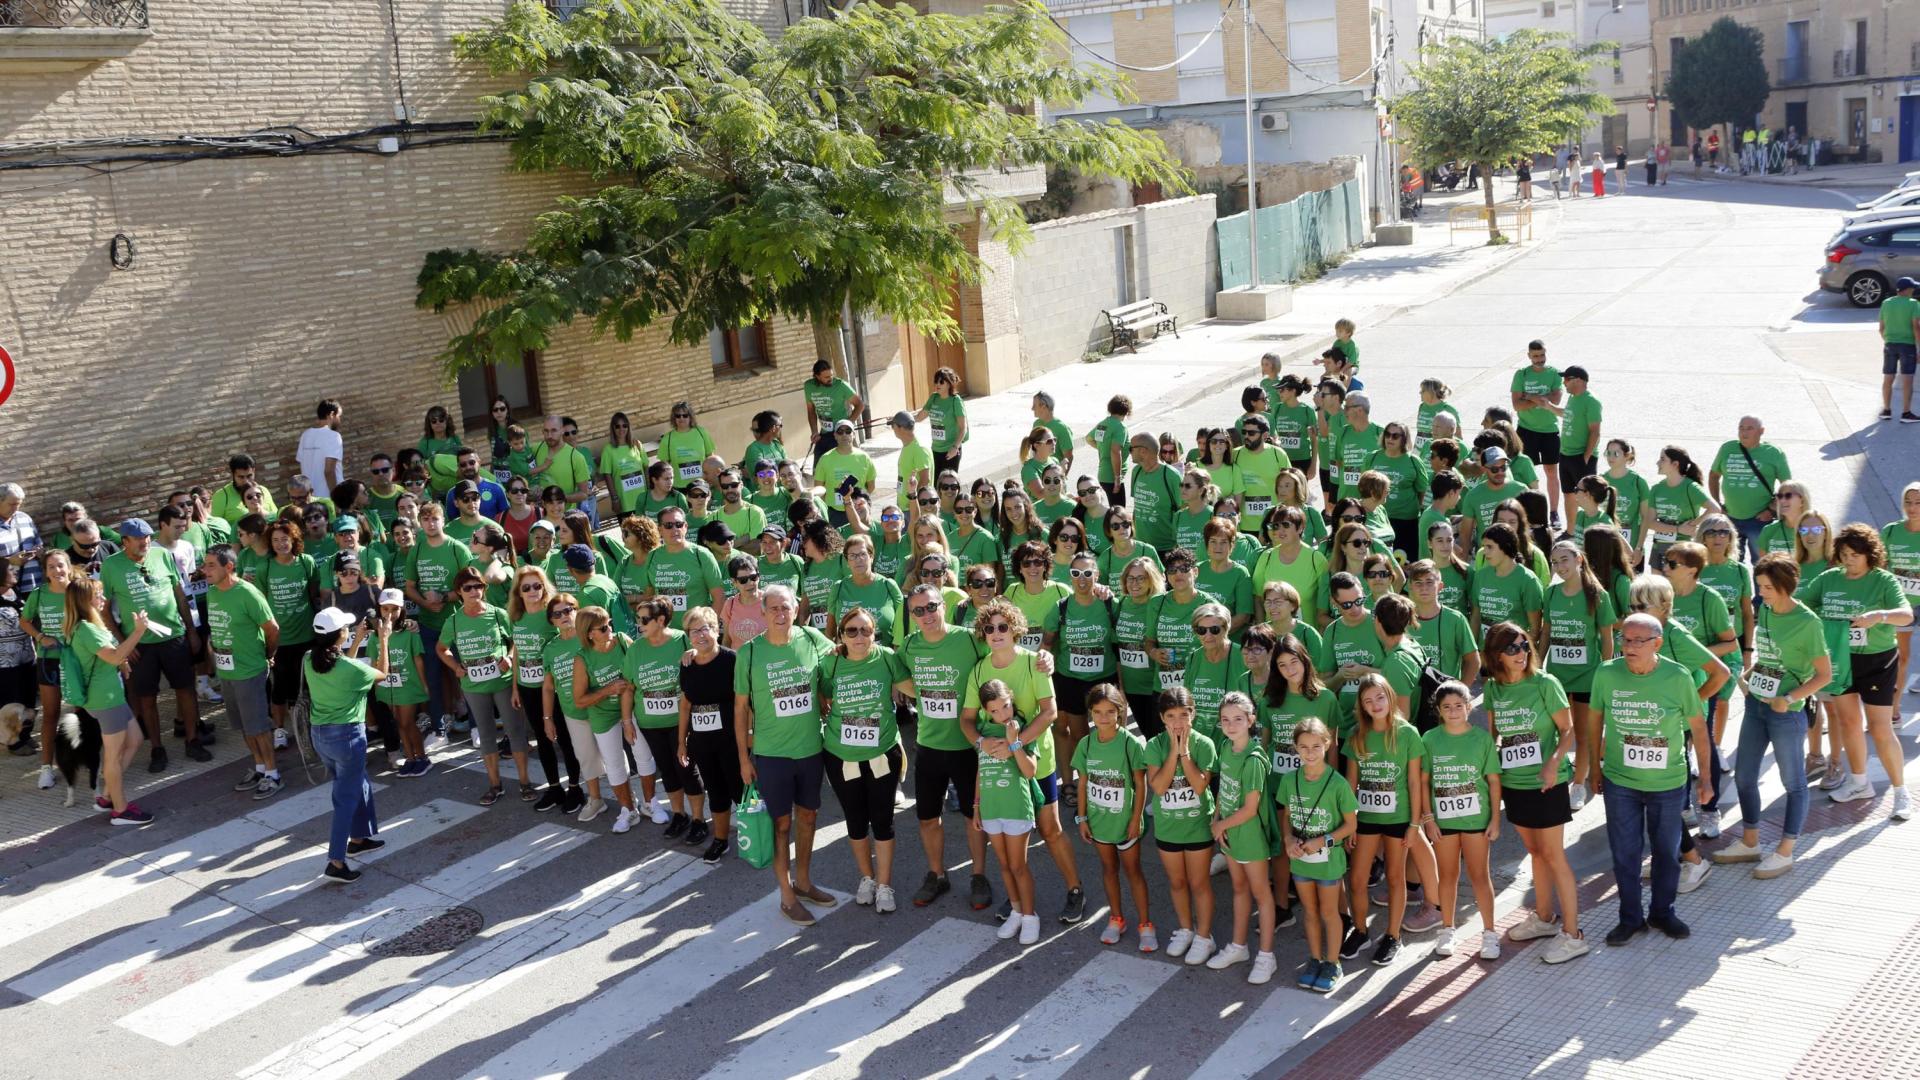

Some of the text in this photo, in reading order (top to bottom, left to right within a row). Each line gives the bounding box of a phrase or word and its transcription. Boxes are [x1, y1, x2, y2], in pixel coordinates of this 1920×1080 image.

[496, 471, 510, 479] 1903
[683, 467, 700, 476] 1865
[1345, 473, 1359, 481] 013
[625, 478, 642, 487] 1868
[1248, 503, 1268, 511] 1881
[1075, 624, 1102, 632] marcha
[465, 635, 491, 644] marcha
[1121, 652, 1143, 663] 0271
[1343, 649, 1368, 658] marcha
[1555, 648, 1582, 658] 1869
[1073, 657, 1099, 667] 0281
[470, 664, 496, 678] 0129
[521, 669, 544, 679] 0120
[648, 665, 674, 675] marcha
[779, 666, 807, 677] marcha
[923, 665, 952, 673] marcha
[640, 675, 661, 685] contra
[769, 677, 793, 686] contra
[847, 680, 877, 690] marcha
[1752, 679, 1774, 691] 0188
[837, 689, 862, 697] contra
[647, 700, 674, 710] 0109
[779, 696, 809, 711] 0166
[924, 700, 952, 712] 1841
[1623, 701, 1658, 709] marcha
[1502, 707, 1530, 716] marcha
[693, 715, 717, 726] 1907
[844, 728, 875, 740] 0165
[1506, 746, 1535, 762] 0189
[1628, 749, 1662, 761] 0186
[1277, 756, 1301, 768] 018
[1443, 764, 1476, 773] marcha
[1091, 787, 1119, 802] 0161
[1164, 789, 1194, 804] 0142
[1361, 793, 1391, 806] 0180
[1440, 797, 1473, 812] 0187
